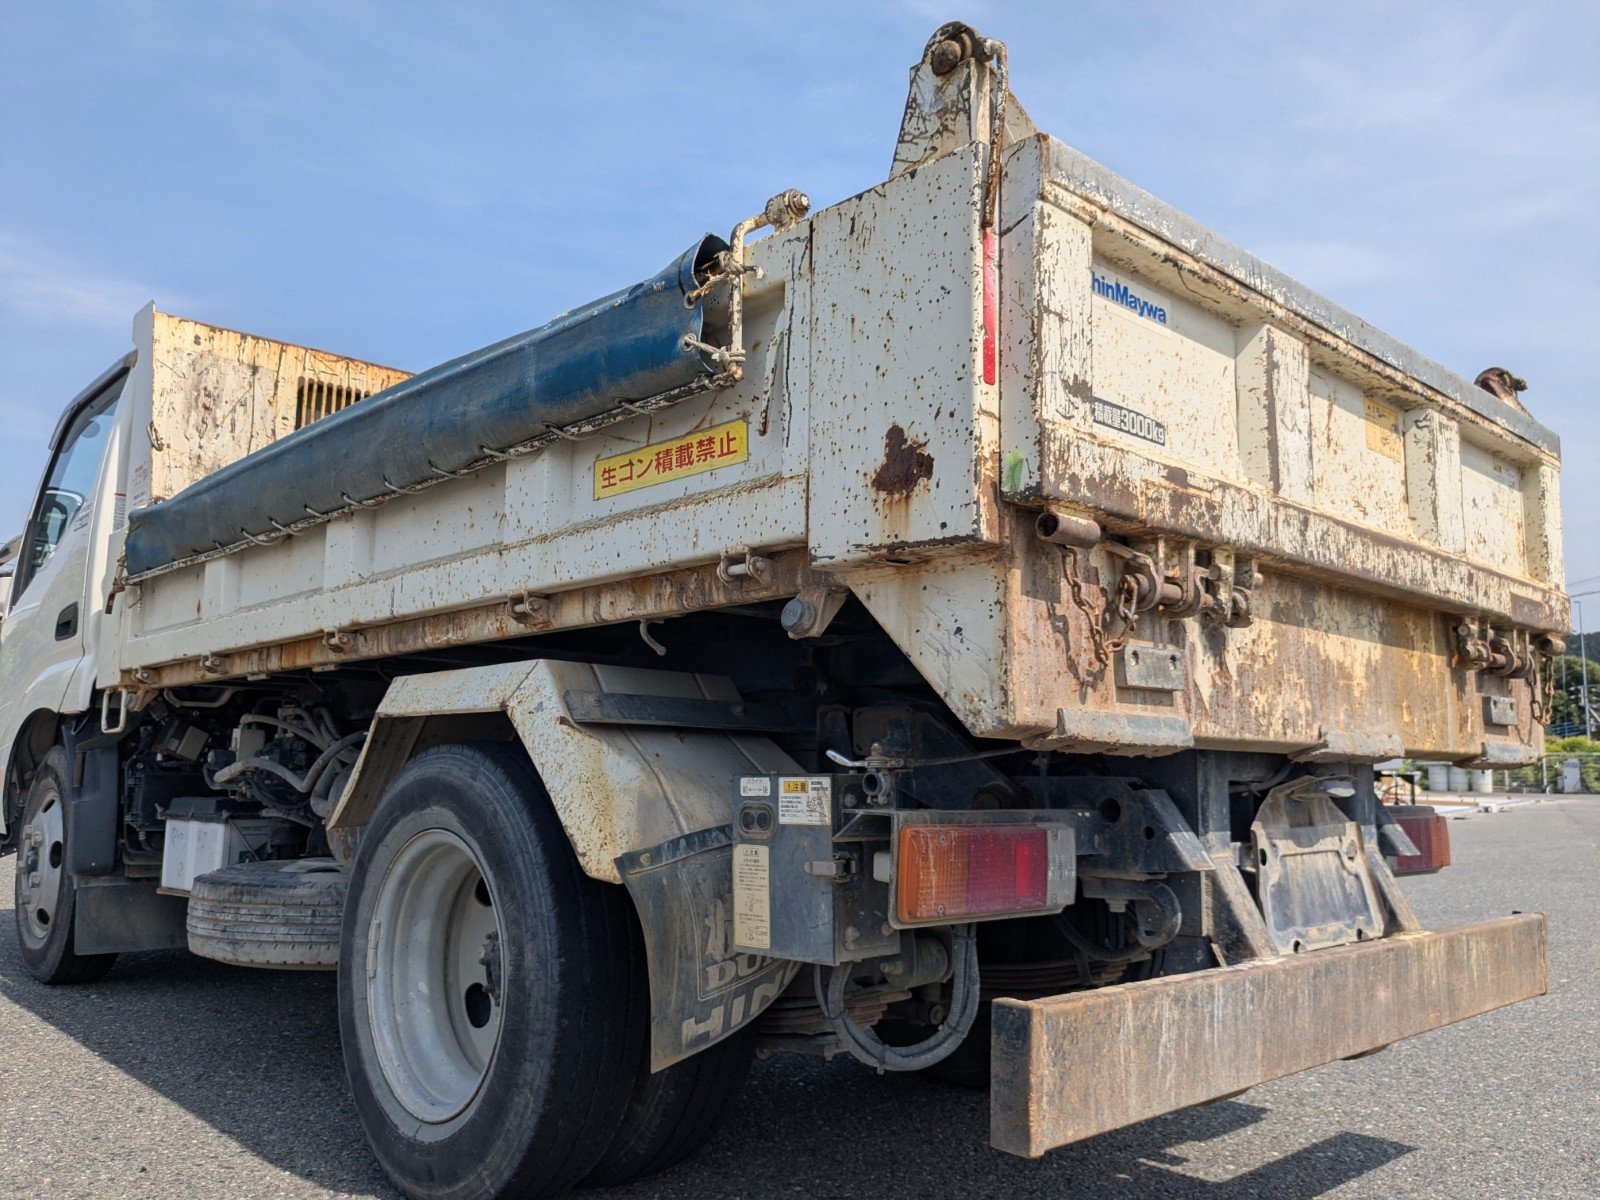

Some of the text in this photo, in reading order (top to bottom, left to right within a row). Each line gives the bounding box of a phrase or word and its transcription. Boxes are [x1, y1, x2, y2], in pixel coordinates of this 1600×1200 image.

[601, 431, 738, 489] 生コン積載禁止
[706, 953, 772, 990] DU
